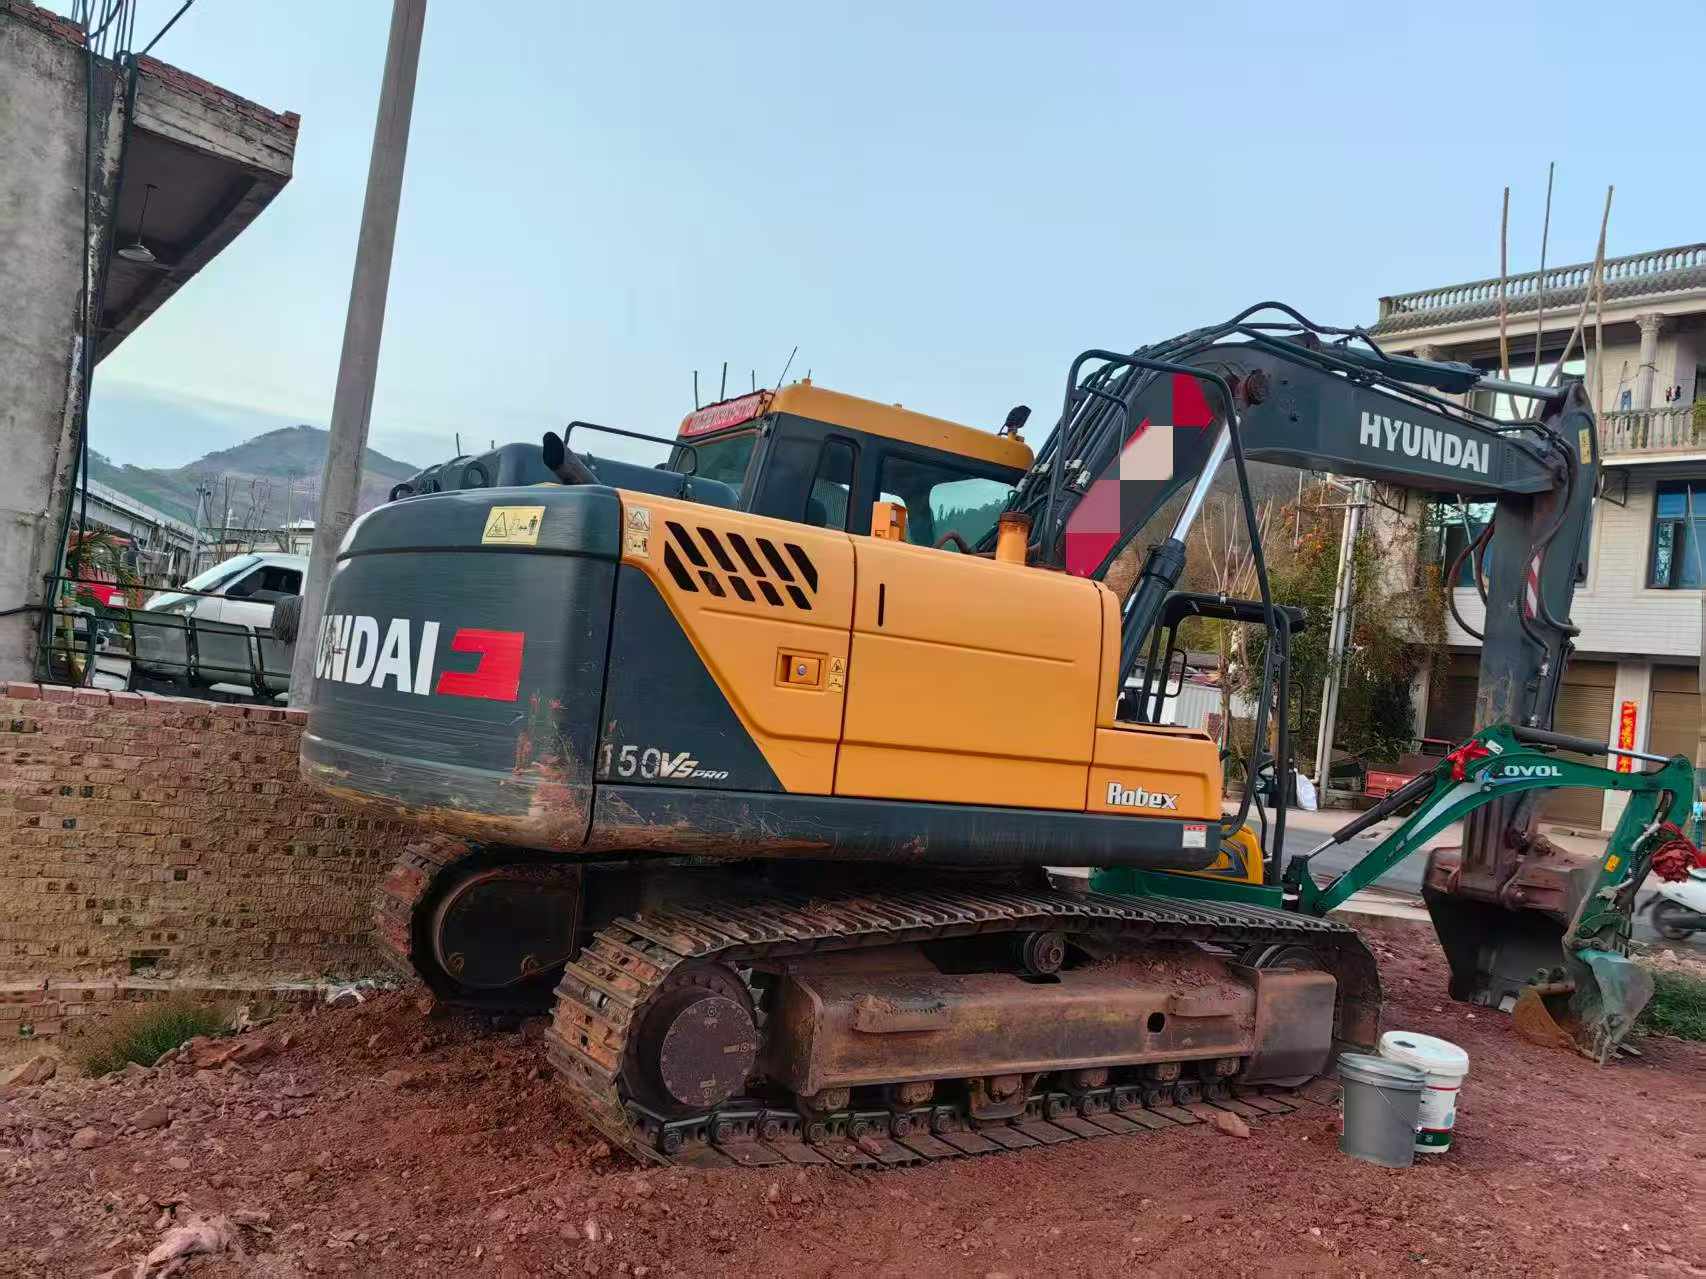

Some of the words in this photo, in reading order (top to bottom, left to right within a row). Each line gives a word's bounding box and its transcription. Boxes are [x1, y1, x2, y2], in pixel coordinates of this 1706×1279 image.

[1360, 411, 1490, 474] HYUNDAI
[1498, 765, 1563, 777] OVOL
[1106, 781, 1179, 811] Robex
